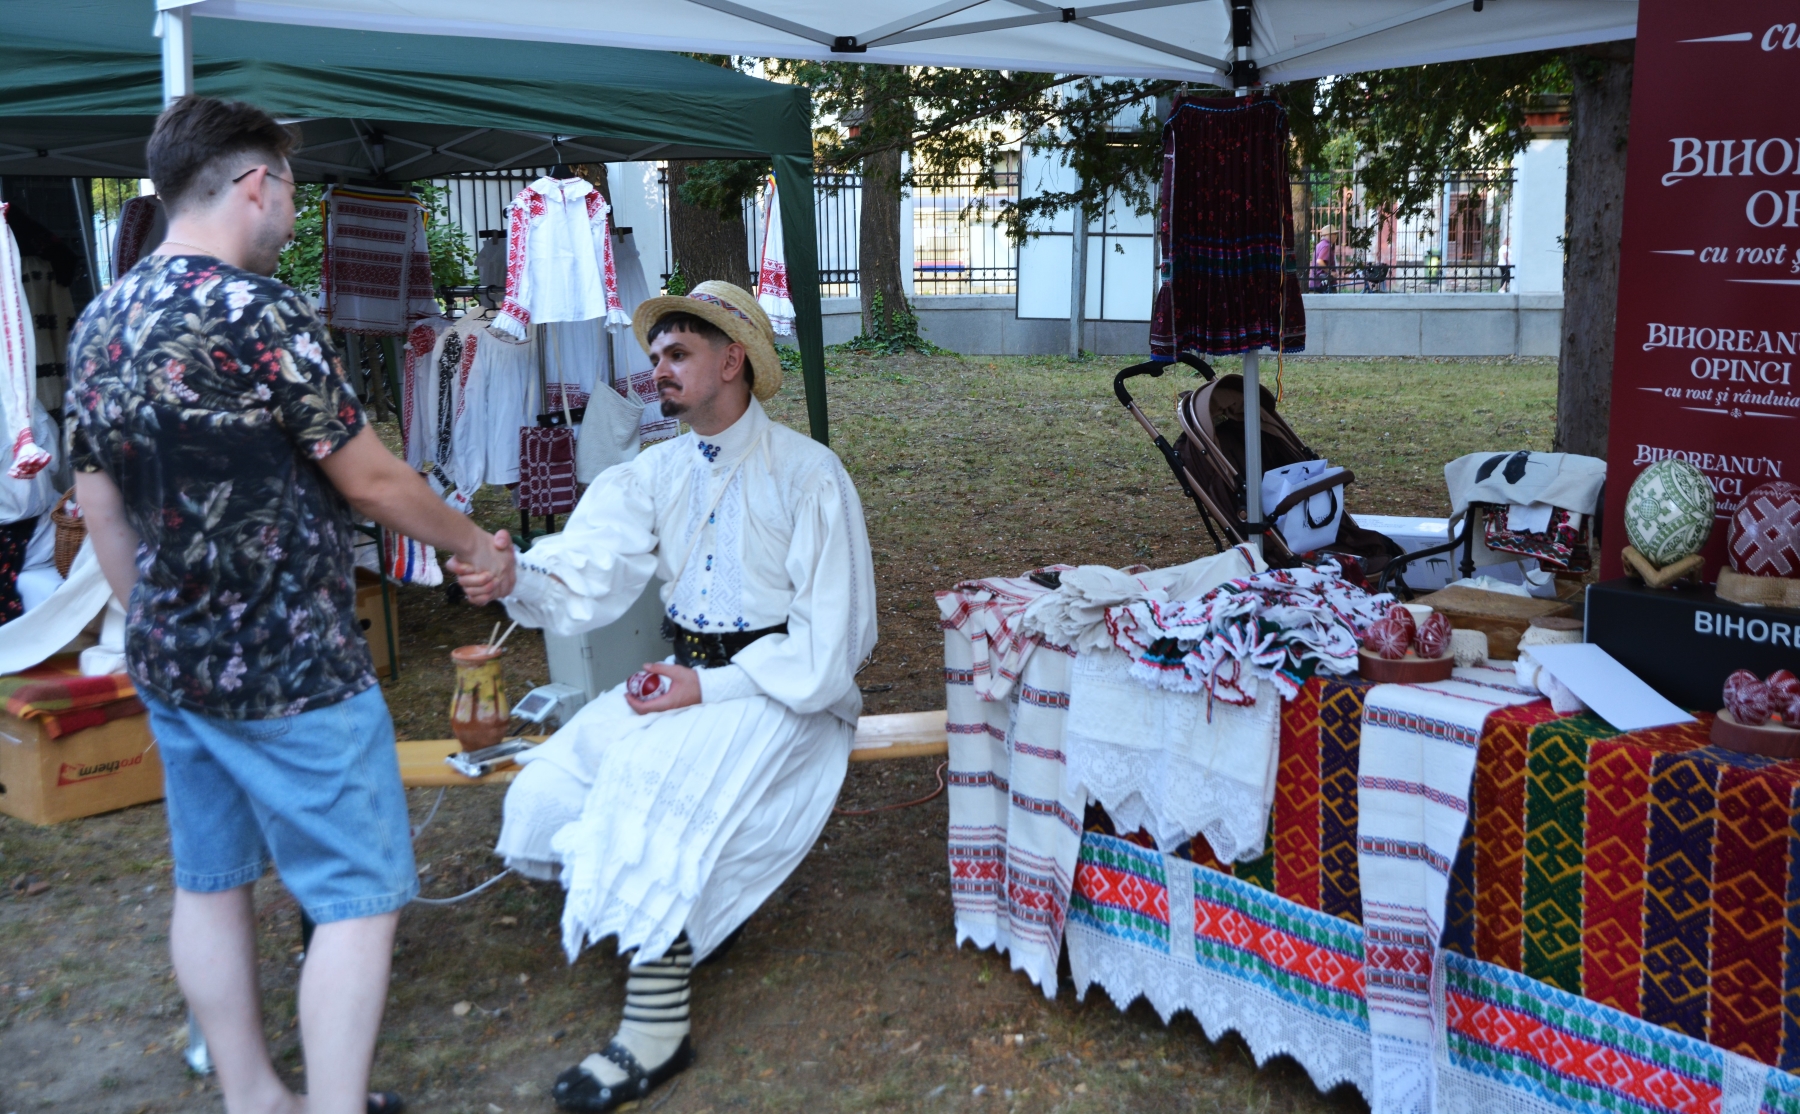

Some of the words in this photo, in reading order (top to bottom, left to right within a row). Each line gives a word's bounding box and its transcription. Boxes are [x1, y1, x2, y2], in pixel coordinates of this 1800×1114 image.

[1699, 246, 1728, 263] cu
[1736, 243, 1787, 264] rost
[1642, 322, 1800, 355] BIHOREAN
[1690, 356, 1792, 385] OPINCI
[1664, 386, 1681, 398] cu
[1685, 387, 1713, 401] rost
[78, 752, 144, 777] protherm
